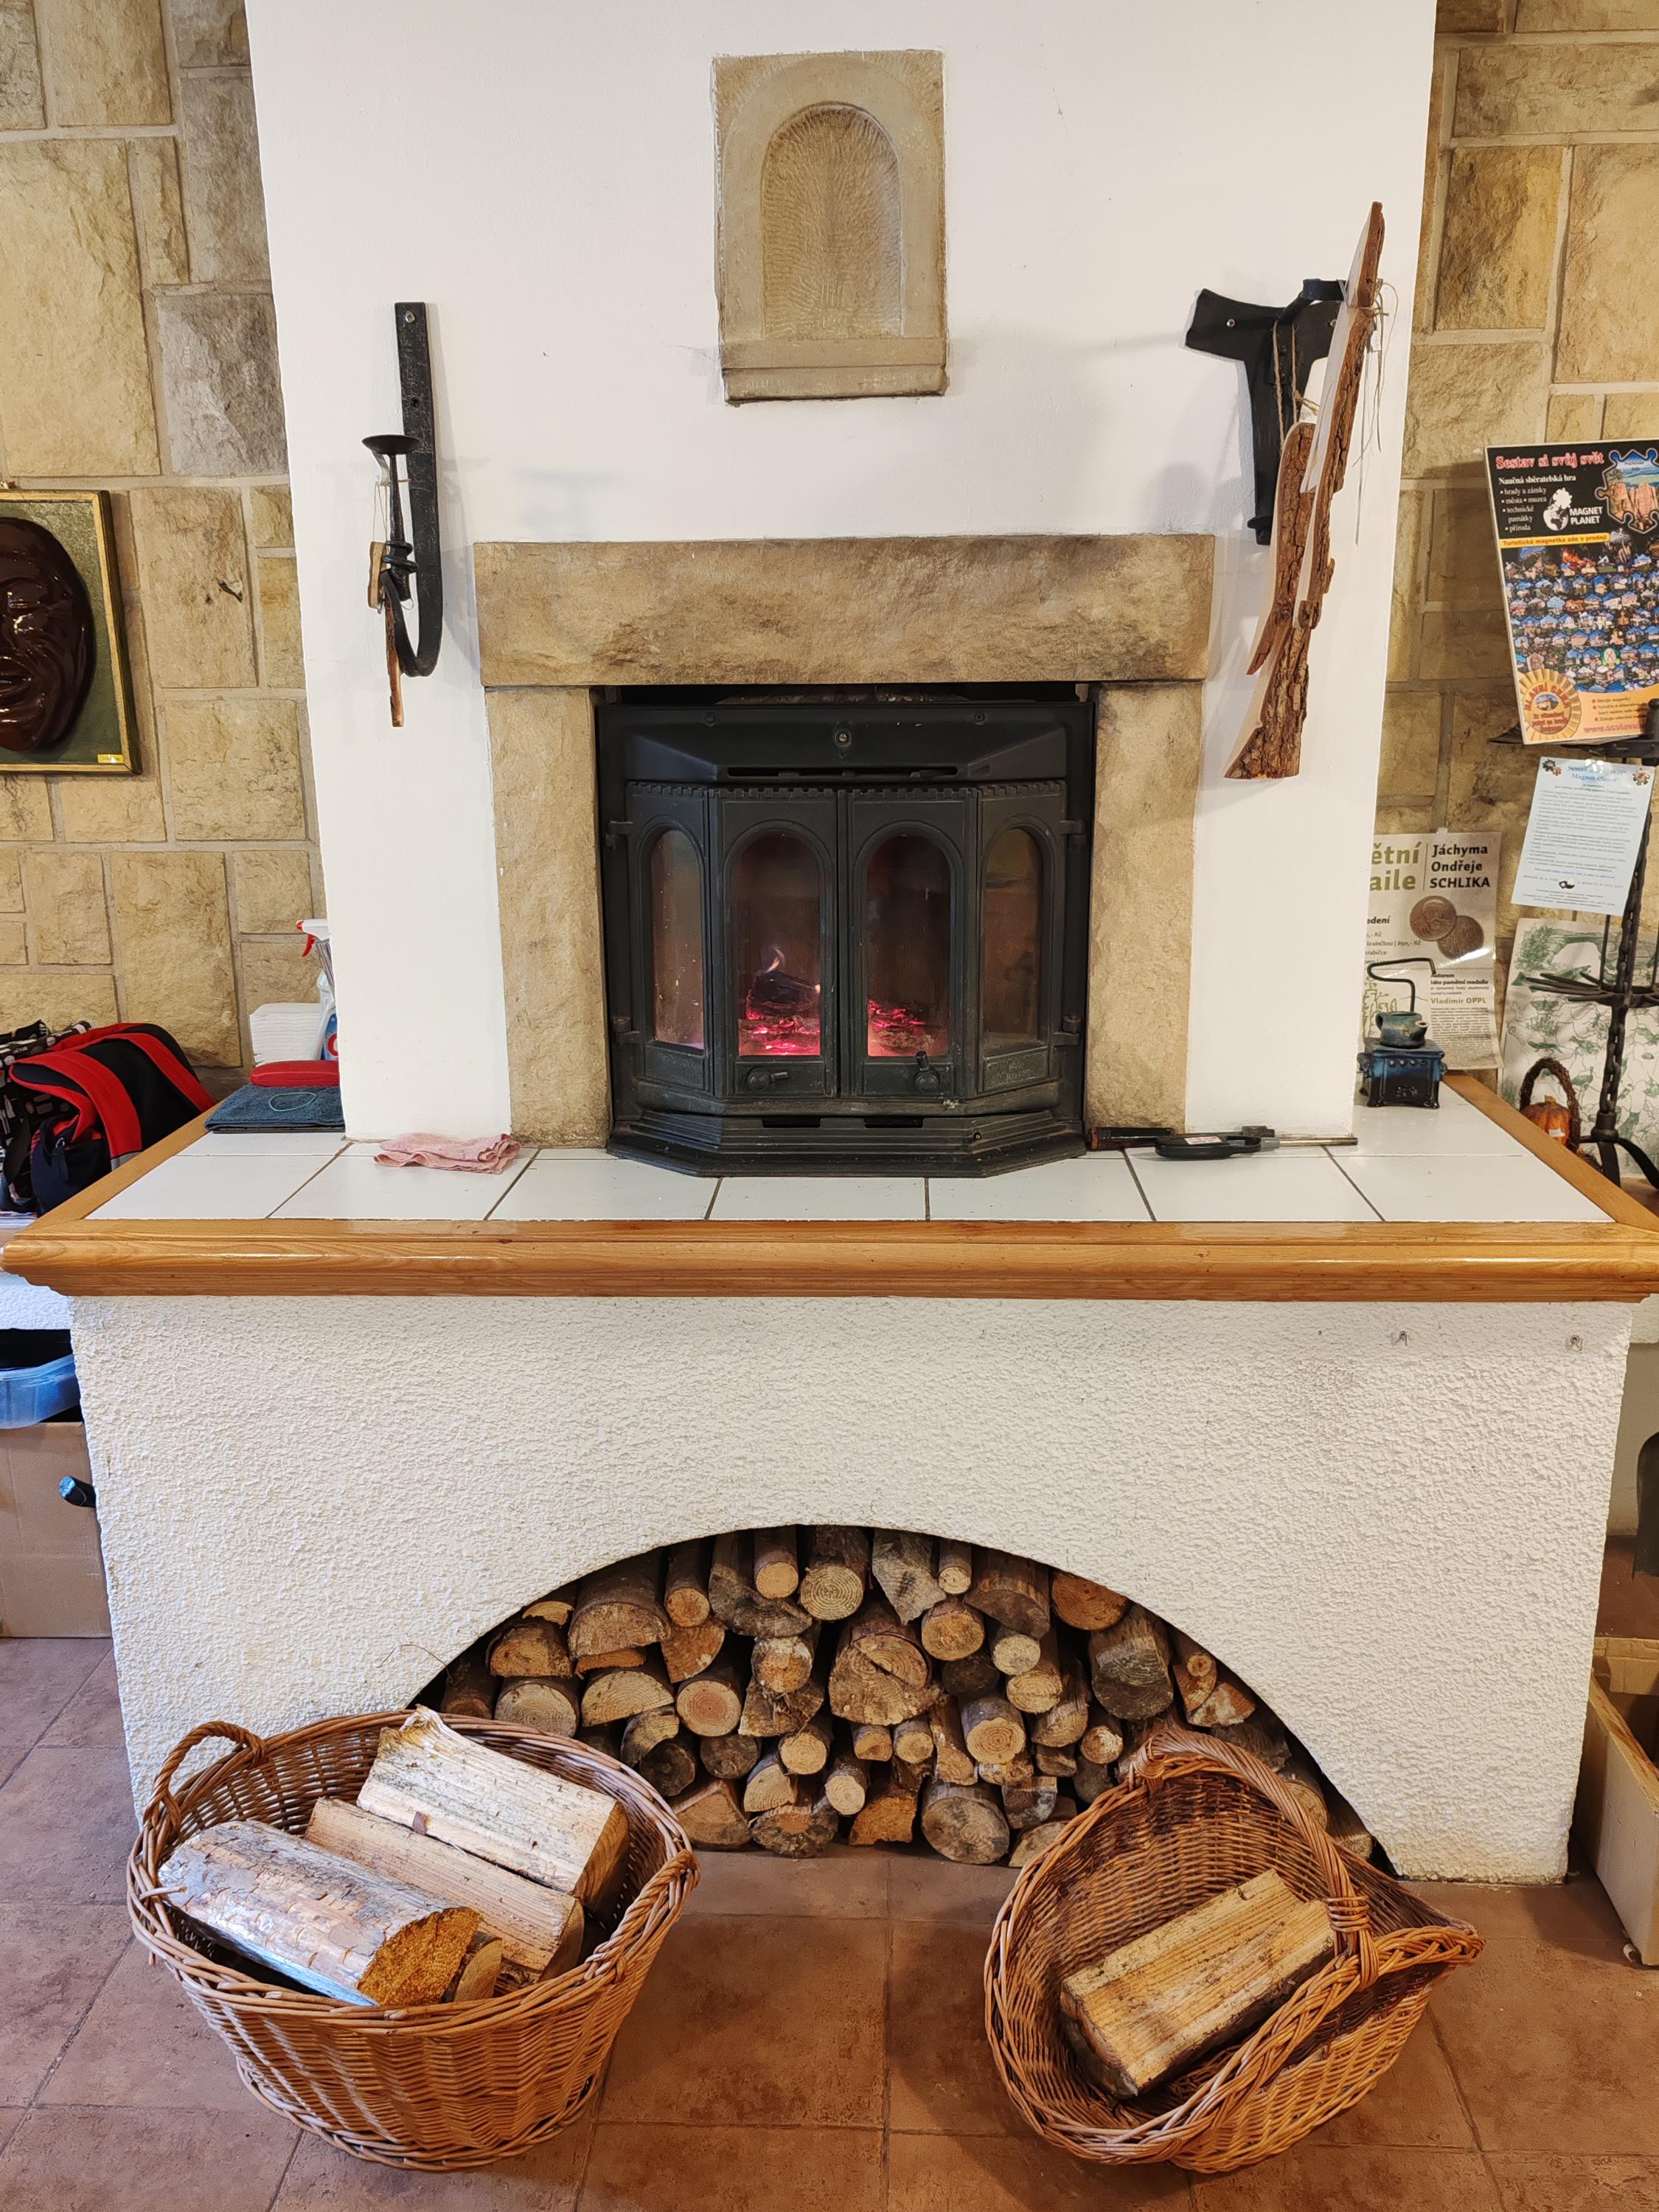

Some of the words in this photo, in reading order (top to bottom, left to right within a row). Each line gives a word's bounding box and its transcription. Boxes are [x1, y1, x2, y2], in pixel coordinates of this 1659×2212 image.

[1495, 456, 1534, 470] Sestav
[1538, 453, 1549, 467] si
[1551, 452, 1578, 469] svůj
[1580, 451, 1604, 465] svět
[1498, 477, 1524, 485] Naučná
[1526, 474, 1562, 484] sběratelská
[1504, 488, 1520, 496] hrady
[1528, 487, 1547, 495] zámky
[1506, 505, 1534, 513] technické
[1569, 507, 1603, 516] MAGNET
[1508, 515, 1533, 524] památky
[1571, 516, 1601, 525] PLANET
[1509, 524, 1531, 533] příroda
[1431, 844, 1488, 858] Jáchyma
[1431, 860, 1483, 874] Ondřeje
[1430, 877, 1490, 888] SCHLIKA
